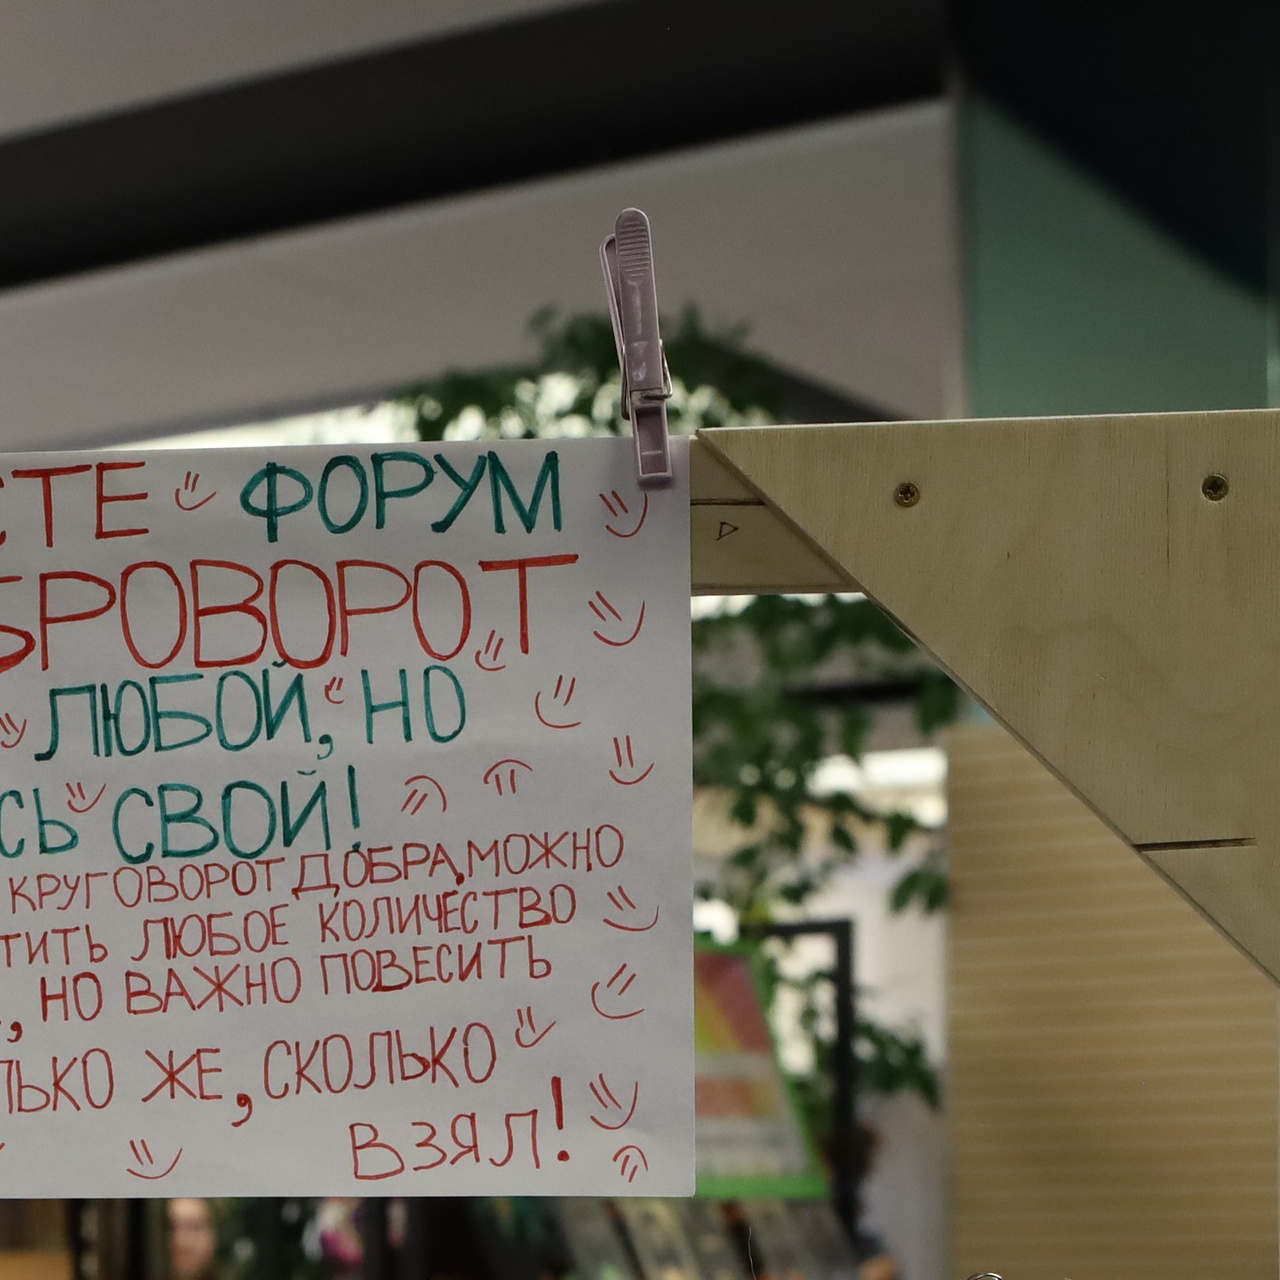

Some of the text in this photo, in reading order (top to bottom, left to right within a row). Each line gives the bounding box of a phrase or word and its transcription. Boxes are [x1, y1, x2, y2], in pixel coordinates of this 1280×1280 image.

[238, 448, 566, 544] ФОРУМ
[358, 662, 470, 746] НО
[8, 856, 287, 916] КРУГОВОРОТ
[128, 900, 292, 964] ЛЮБОЕ
[317, 882, 578, 944] КОЛИЧЕСТВО
[36, 968, 104, 1024] НО
[123, 954, 303, 1016] ВАЖНО
[318, 932, 554, 997] ПОВЕСИТЬ
[262, 1020, 498, 1100] СКОЛЬКО
